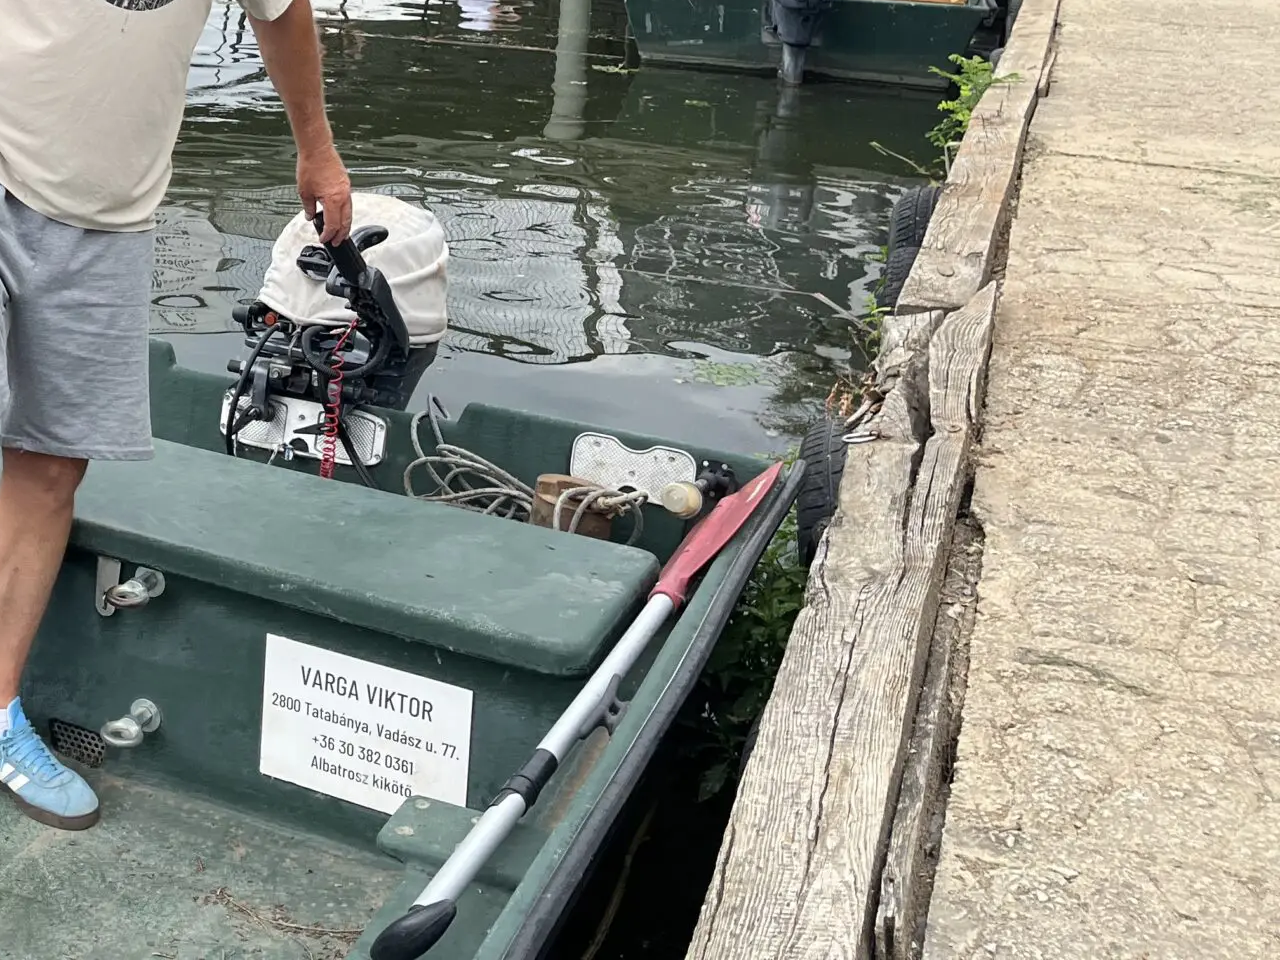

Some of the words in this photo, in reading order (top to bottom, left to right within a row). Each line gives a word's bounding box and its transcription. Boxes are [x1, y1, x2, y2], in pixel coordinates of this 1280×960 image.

[301, 665, 359, 701] VARGA
[366, 684, 434, 722] VIKTOR
[271, 692, 302, 713] 2800
[304, 701, 372, 736] Tatabánya,
[376, 723, 422, 750] Vadász
[425, 744, 438, 755] u.
[441, 742, 461, 761] 77.
[310, 755, 369, 785] Albatrosz
[372, 773, 412, 798] kikötő
[312, 735, 335, 751] +36
[338, 740, 354, 757] 30
[357, 745, 381, 766] 382
[384, 754, 414, 776] 0361
